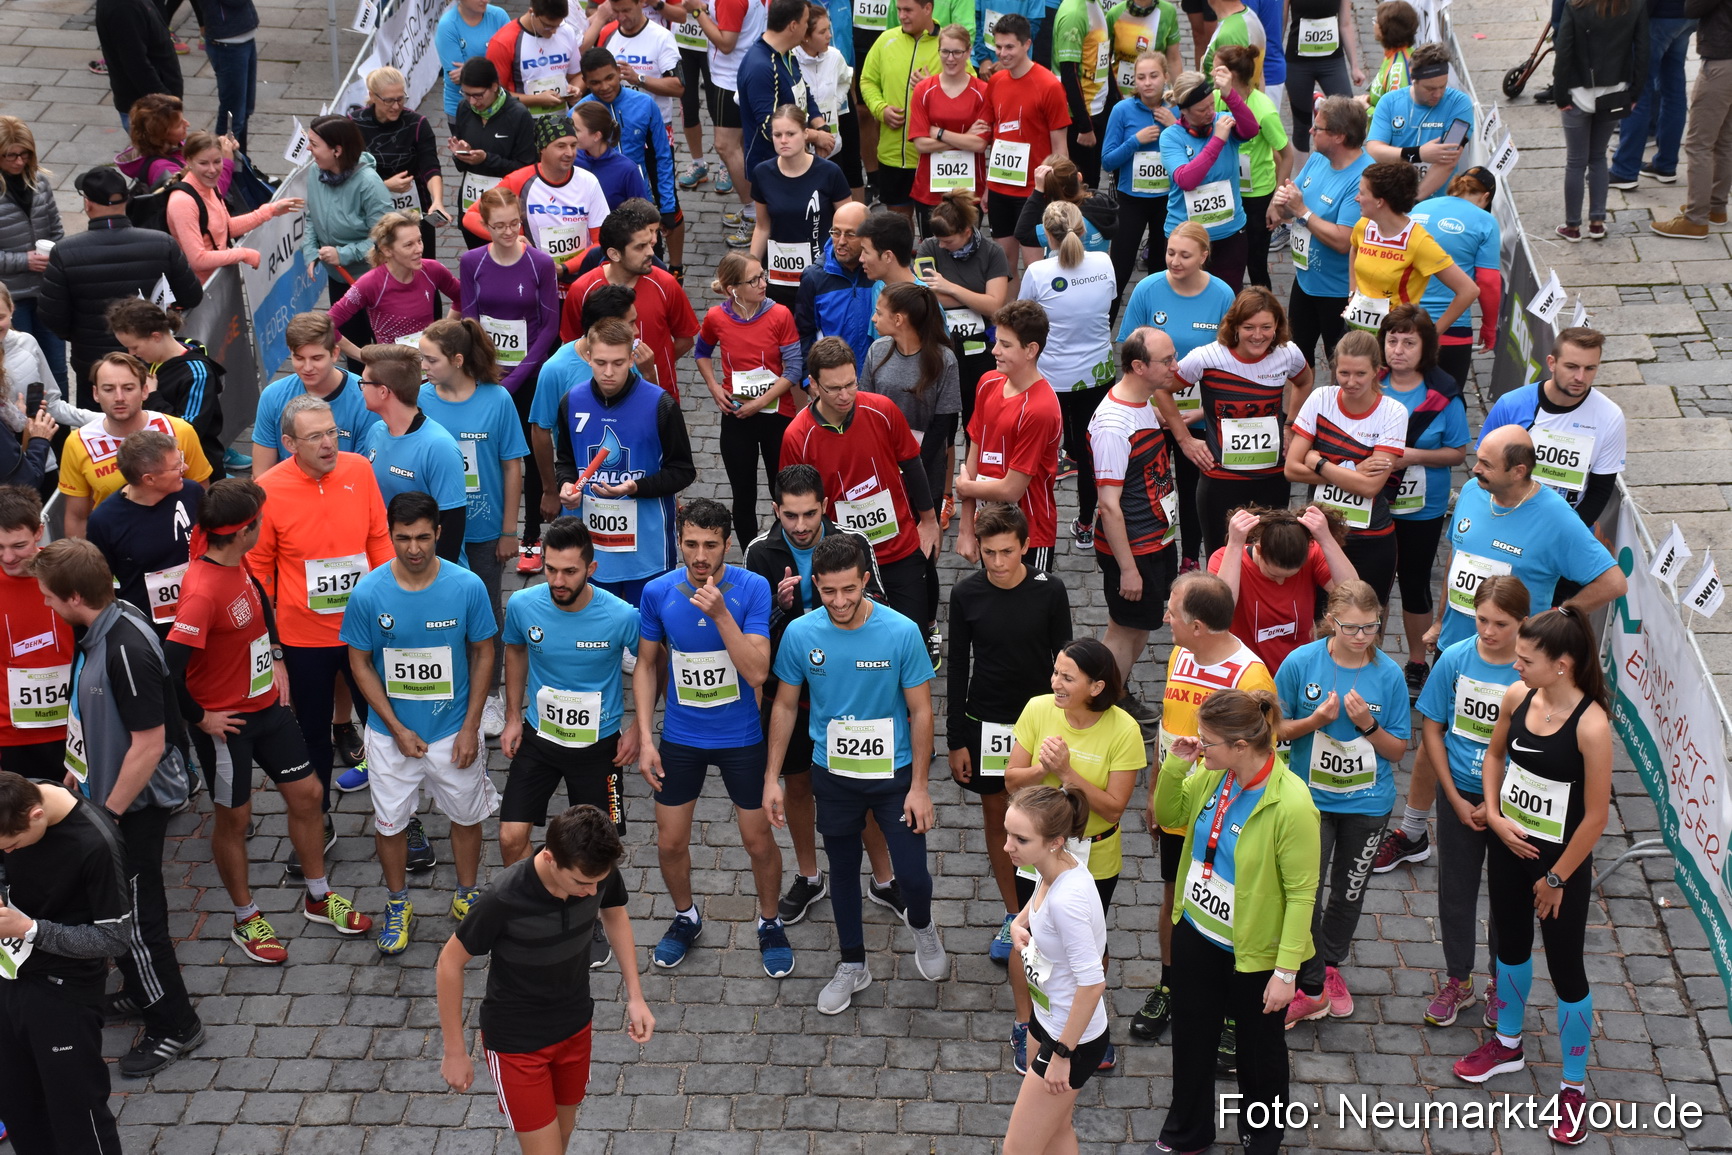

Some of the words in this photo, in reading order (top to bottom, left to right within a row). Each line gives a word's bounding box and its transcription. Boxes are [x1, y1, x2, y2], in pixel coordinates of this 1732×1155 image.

[859, 2, 887, 16] 5140
[359, 8, 372, 29] swn
[1304, 29, 1333, 43] 5025
[291, 136, 306, 160] swn
[994, 154, 1022, 169] 5107
[1496, 147, 1513, 171] swn
[937, 162, 969, 177] 5042
[1193, 194, 1227, 214] 5235
[547, 235, 582, 255] 5030
[1359, 246, 1379, 258] MAX
[1380, 249, 1406, 263] BÖGL
[773, 255, 805, 271] 8009
[1070, 272, 1108, 288] Bionorica
[1348, 307, 1382, 326] 5177
[1192, 321, 1220, 331] BOCK
[574, 412, 592, 433] 7
[460, 431, 489, 441] BOCK
[1231, 433, 1272, 451] 5212
[1535, 444, 1581, 470] 5065
[94, 460, 120, 480] MA
[390, 464, 415, 479] BOCK
[1541, 467, 1567, 479] Michael
[854, 483, 869, 495] DEHN
[589, 513, 628, 532] 8003
[846, 508, 888, 530] 5036
[1492, 540, 1523, 555] BOCK
[317, 571, 362, 593] 5137
[1694, 577, 1720, 608] swn
[236, 609, 253, 622] NEU
[426, 618, 459, 630] BOCK
[1267, 627, 1286, 638] DEHN
[25, 639, 38, 650] DEHN
[576, 640, 611, 649] BOCK
[395, 663, 442, 680] 5180
[855, 660, 891, 669] BOCK
[681, 667, 727, 687] 5187
[19, 683, 69, 706] 5154
[403, 684, 436, 692] Housseini
[695, 690, 718, 700] Ahmad
[1163, 688, 1191, 703] MAX
[34, 708, 59, 719] Martin
[546, 703, 590, 727] 5186
[555, 727, 578, 738] Hamza
[836, 738, 885, 756] 5246
[1320, 751, 1364, 774] 5031
[1331, 776, 1354, 785] Selina
[1508, 784, 1553, 817] 5001
[1517, 812, 1541, 827] Juliane
[1345, 832, 1381, 902] adidas
[1190, 881, 1231, 922] 5208
[255, 943, 286, 951] BROOKS
